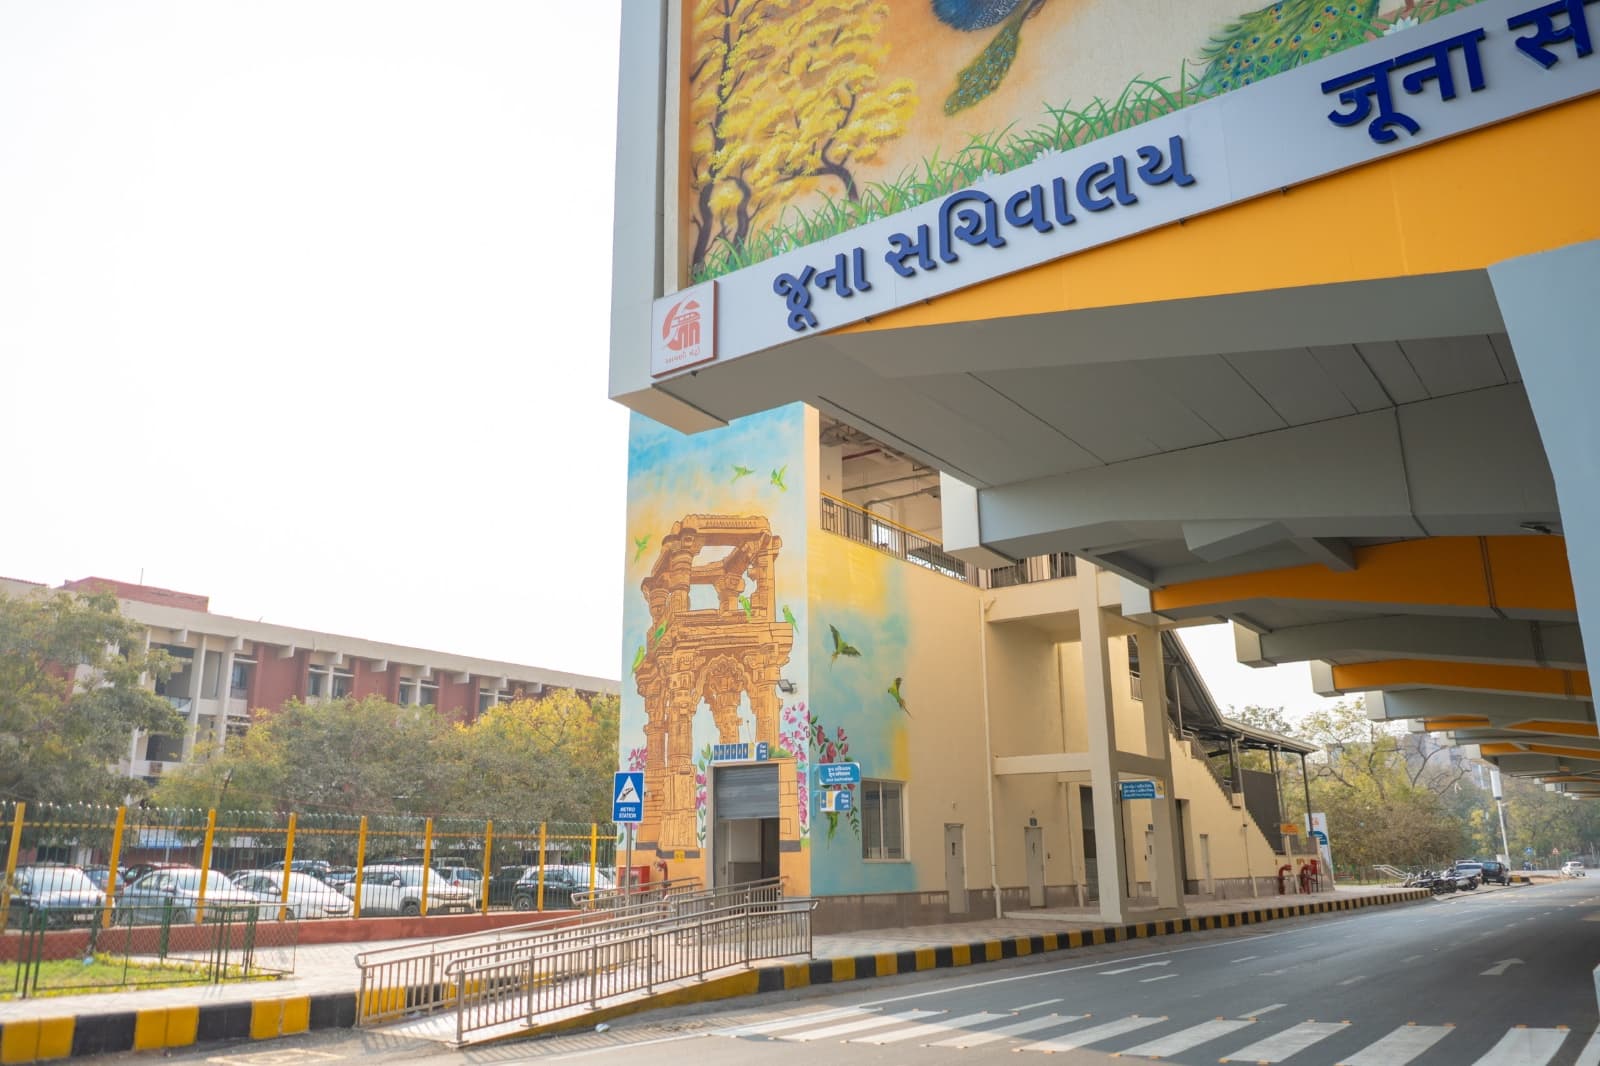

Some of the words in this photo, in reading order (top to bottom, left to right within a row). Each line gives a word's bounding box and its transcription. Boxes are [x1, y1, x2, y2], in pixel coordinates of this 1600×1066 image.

[1320, 27, 1487, 144] जूना
[773, 246, 872, 331] જૂના
[884, 134, 1196, 278] સચિવાલય
